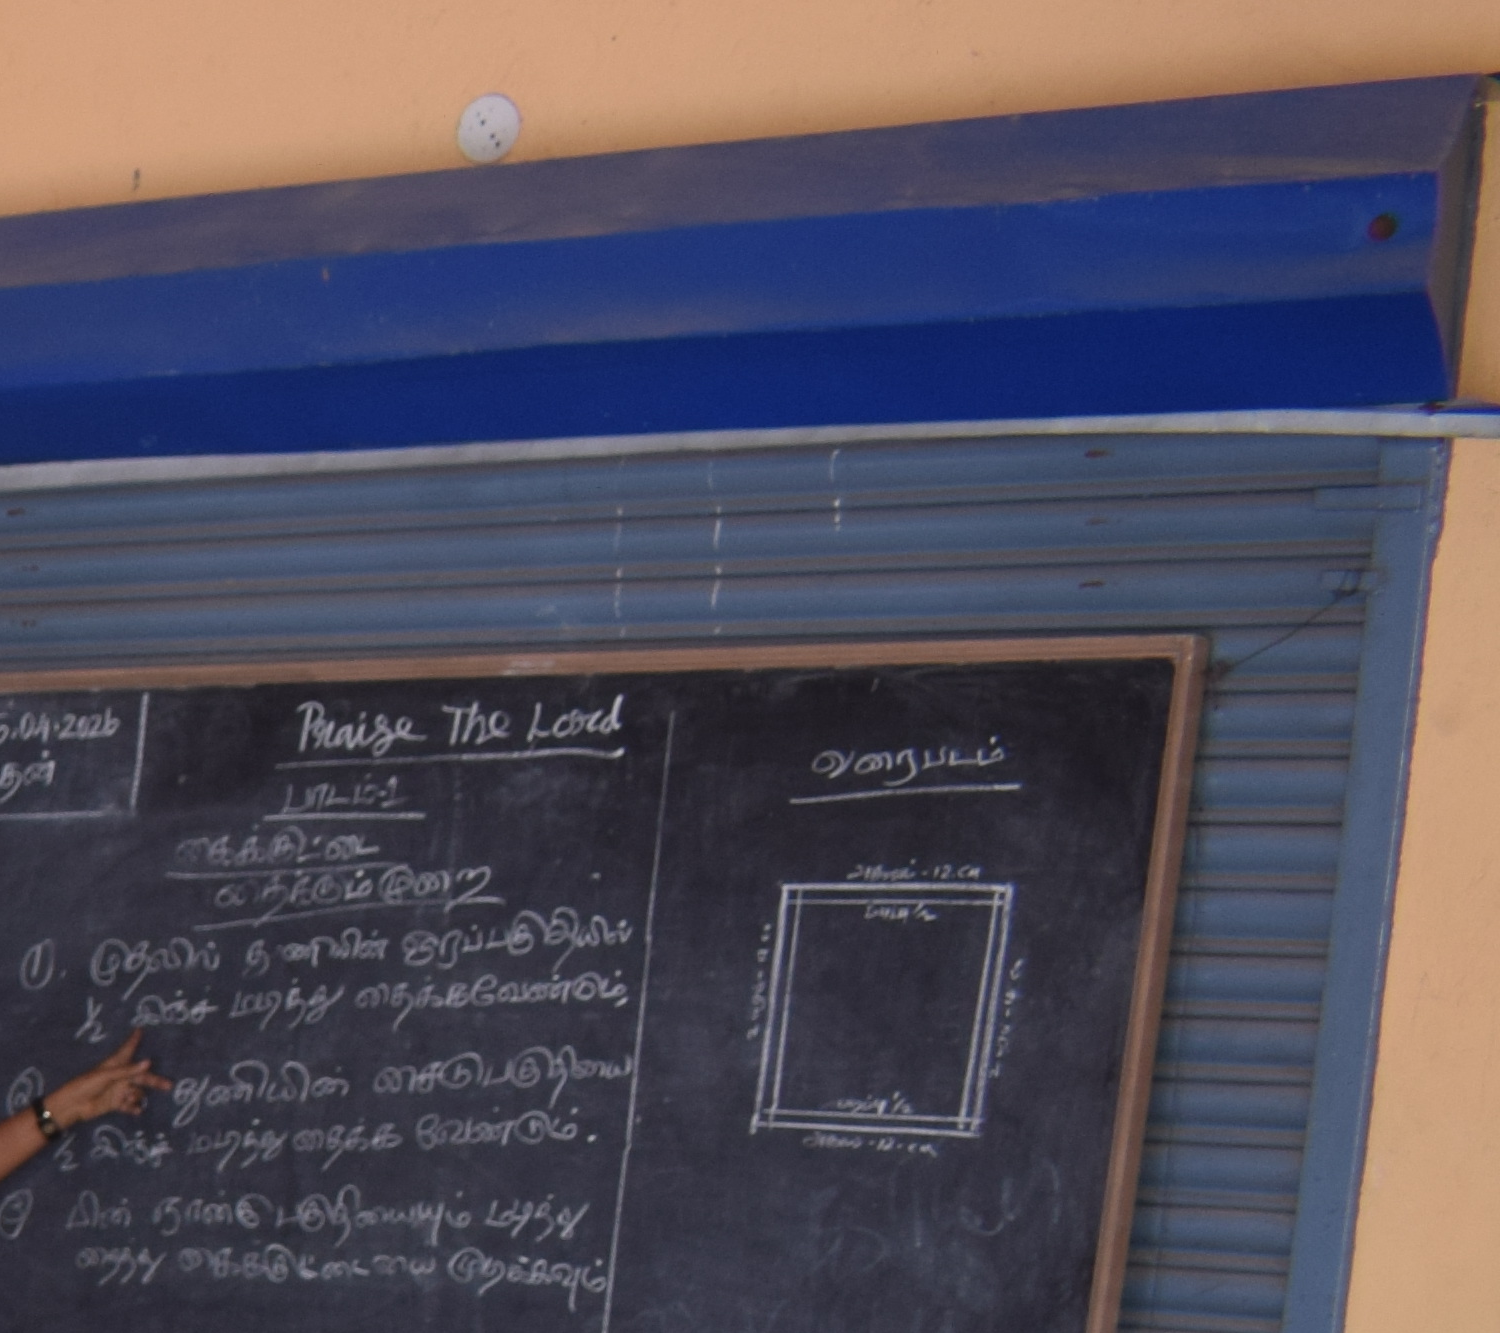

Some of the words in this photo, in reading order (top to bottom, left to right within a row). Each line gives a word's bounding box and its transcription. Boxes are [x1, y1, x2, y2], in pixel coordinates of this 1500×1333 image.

[297, 700, 426, 756] Praise
[442, 702, 509, 746] The
[527, 695, 625, 742] Lord
